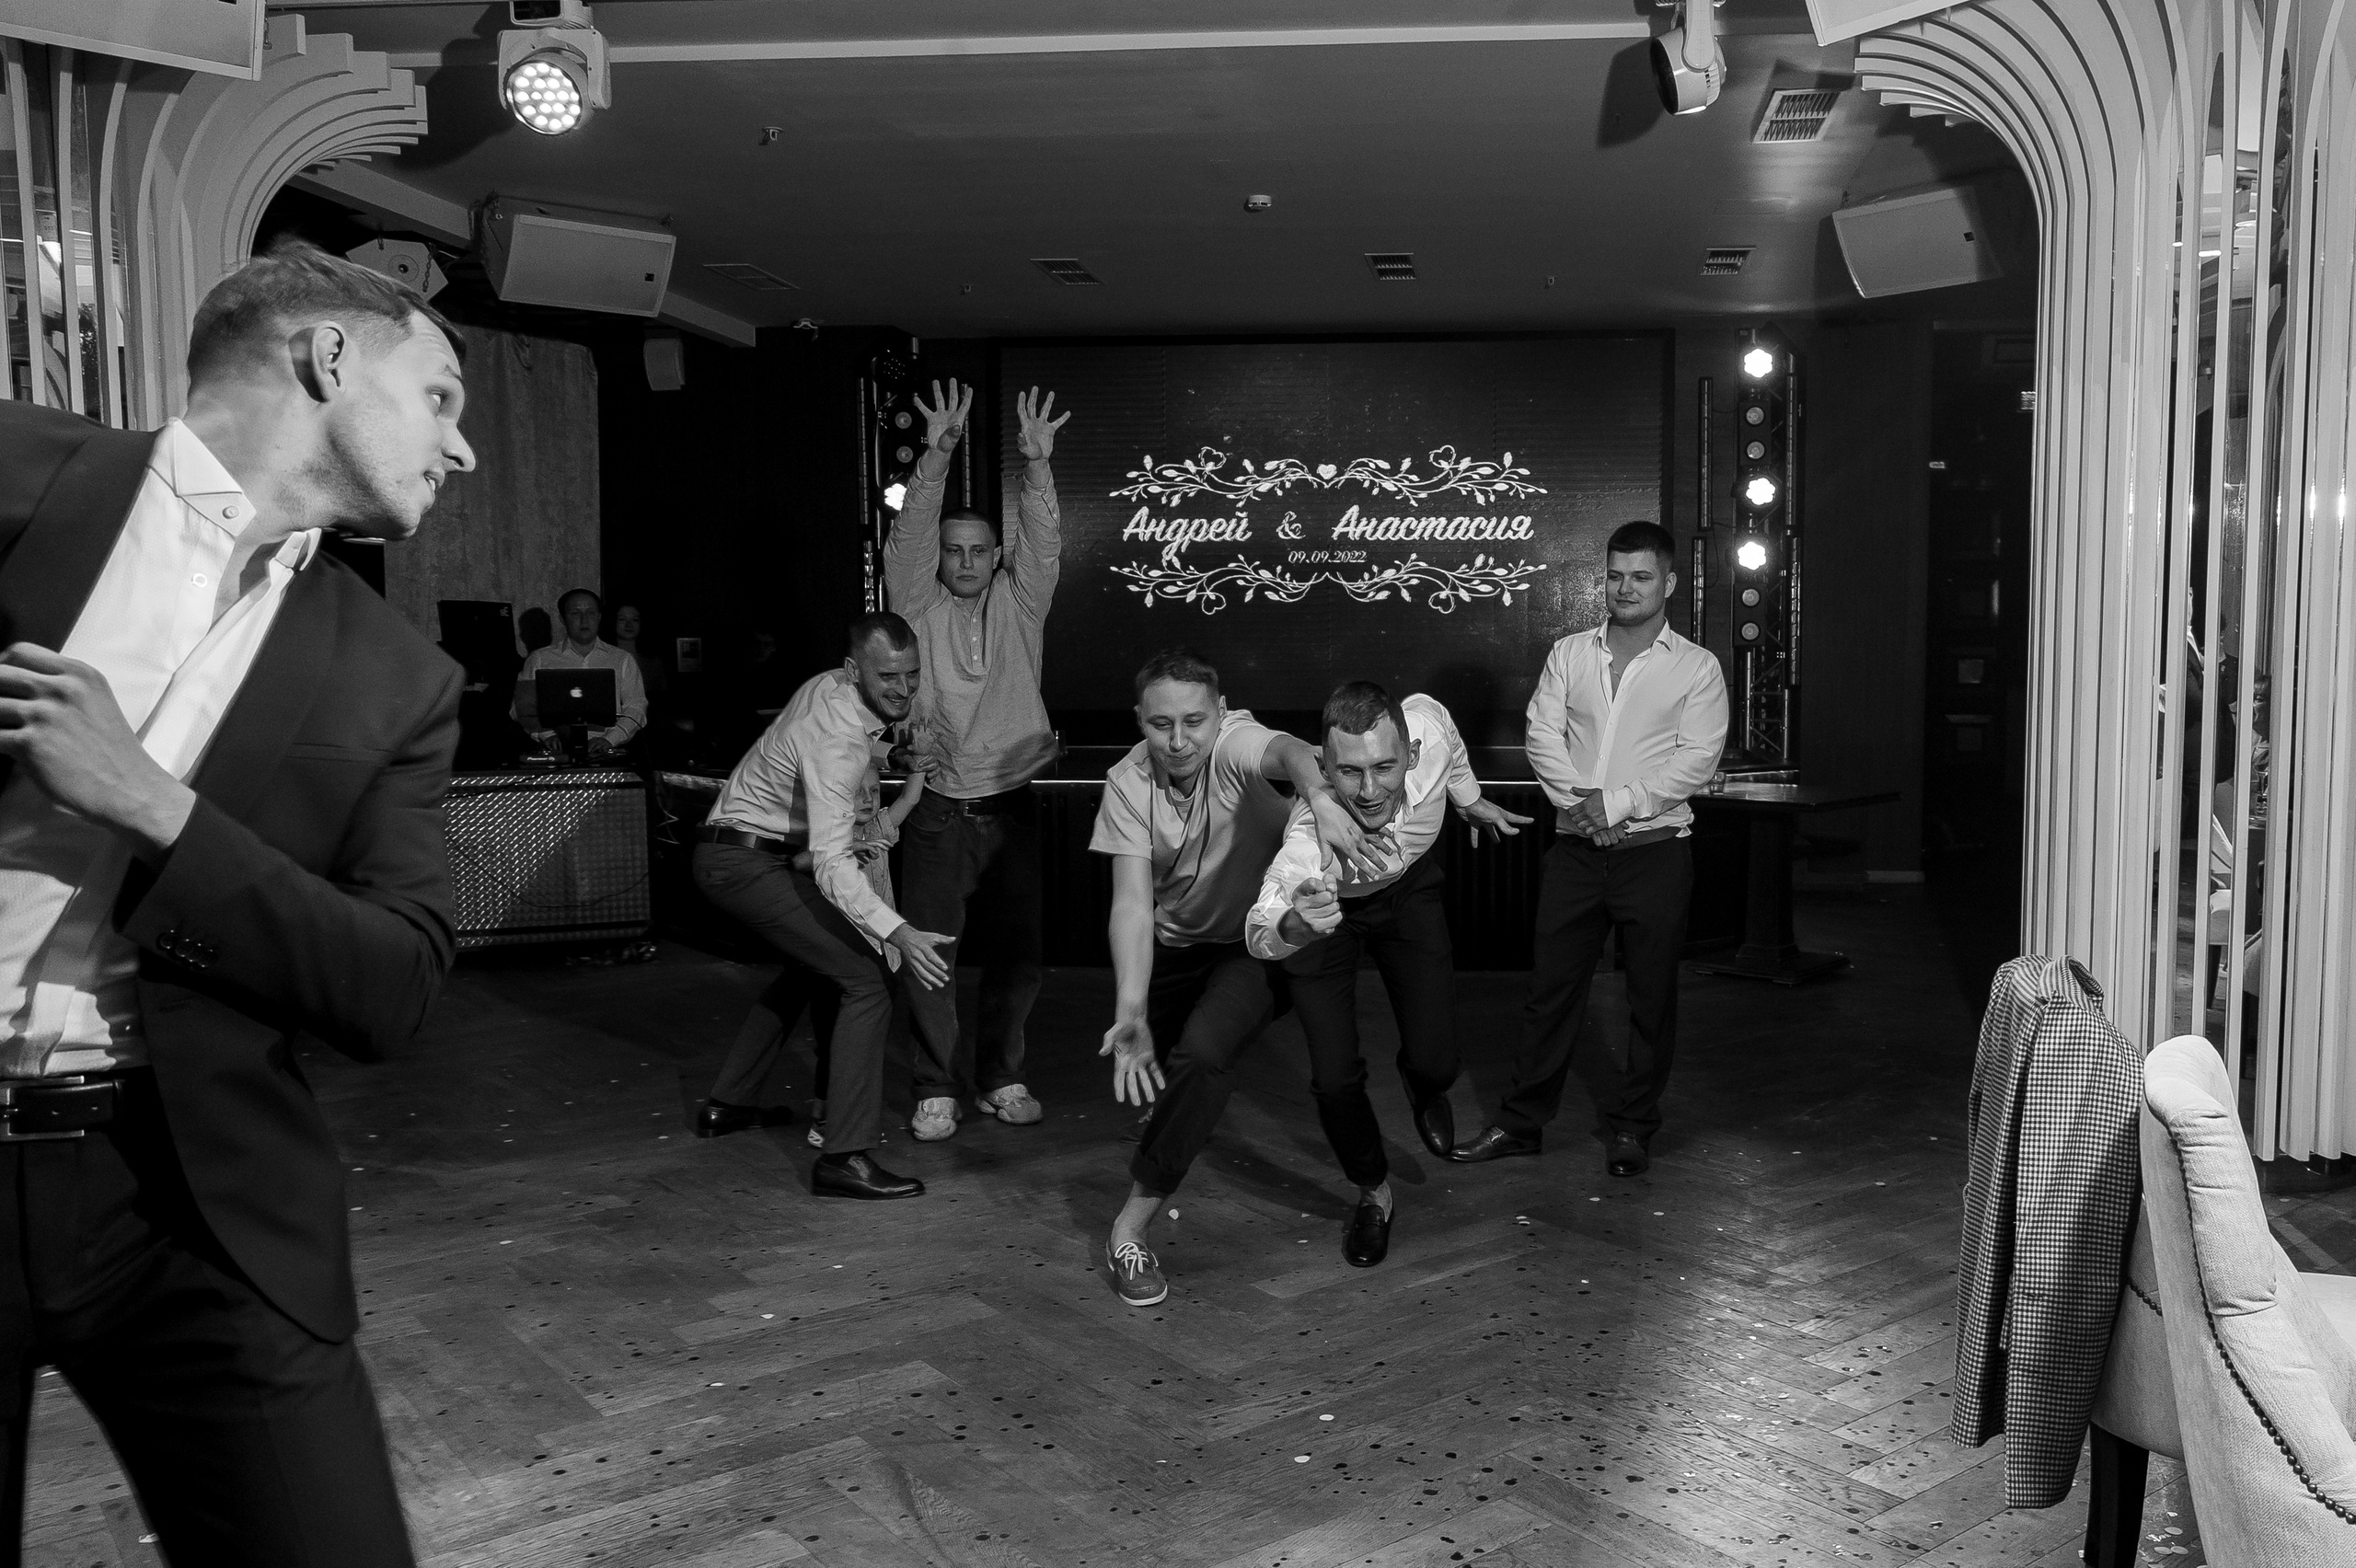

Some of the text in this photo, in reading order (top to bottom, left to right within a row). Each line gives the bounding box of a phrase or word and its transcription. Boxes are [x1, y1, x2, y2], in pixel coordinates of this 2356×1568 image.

[1123, 504, 1534, 560] Андрей & Анастасия
[1288, 550, 1367, 563] 09.09.2022
